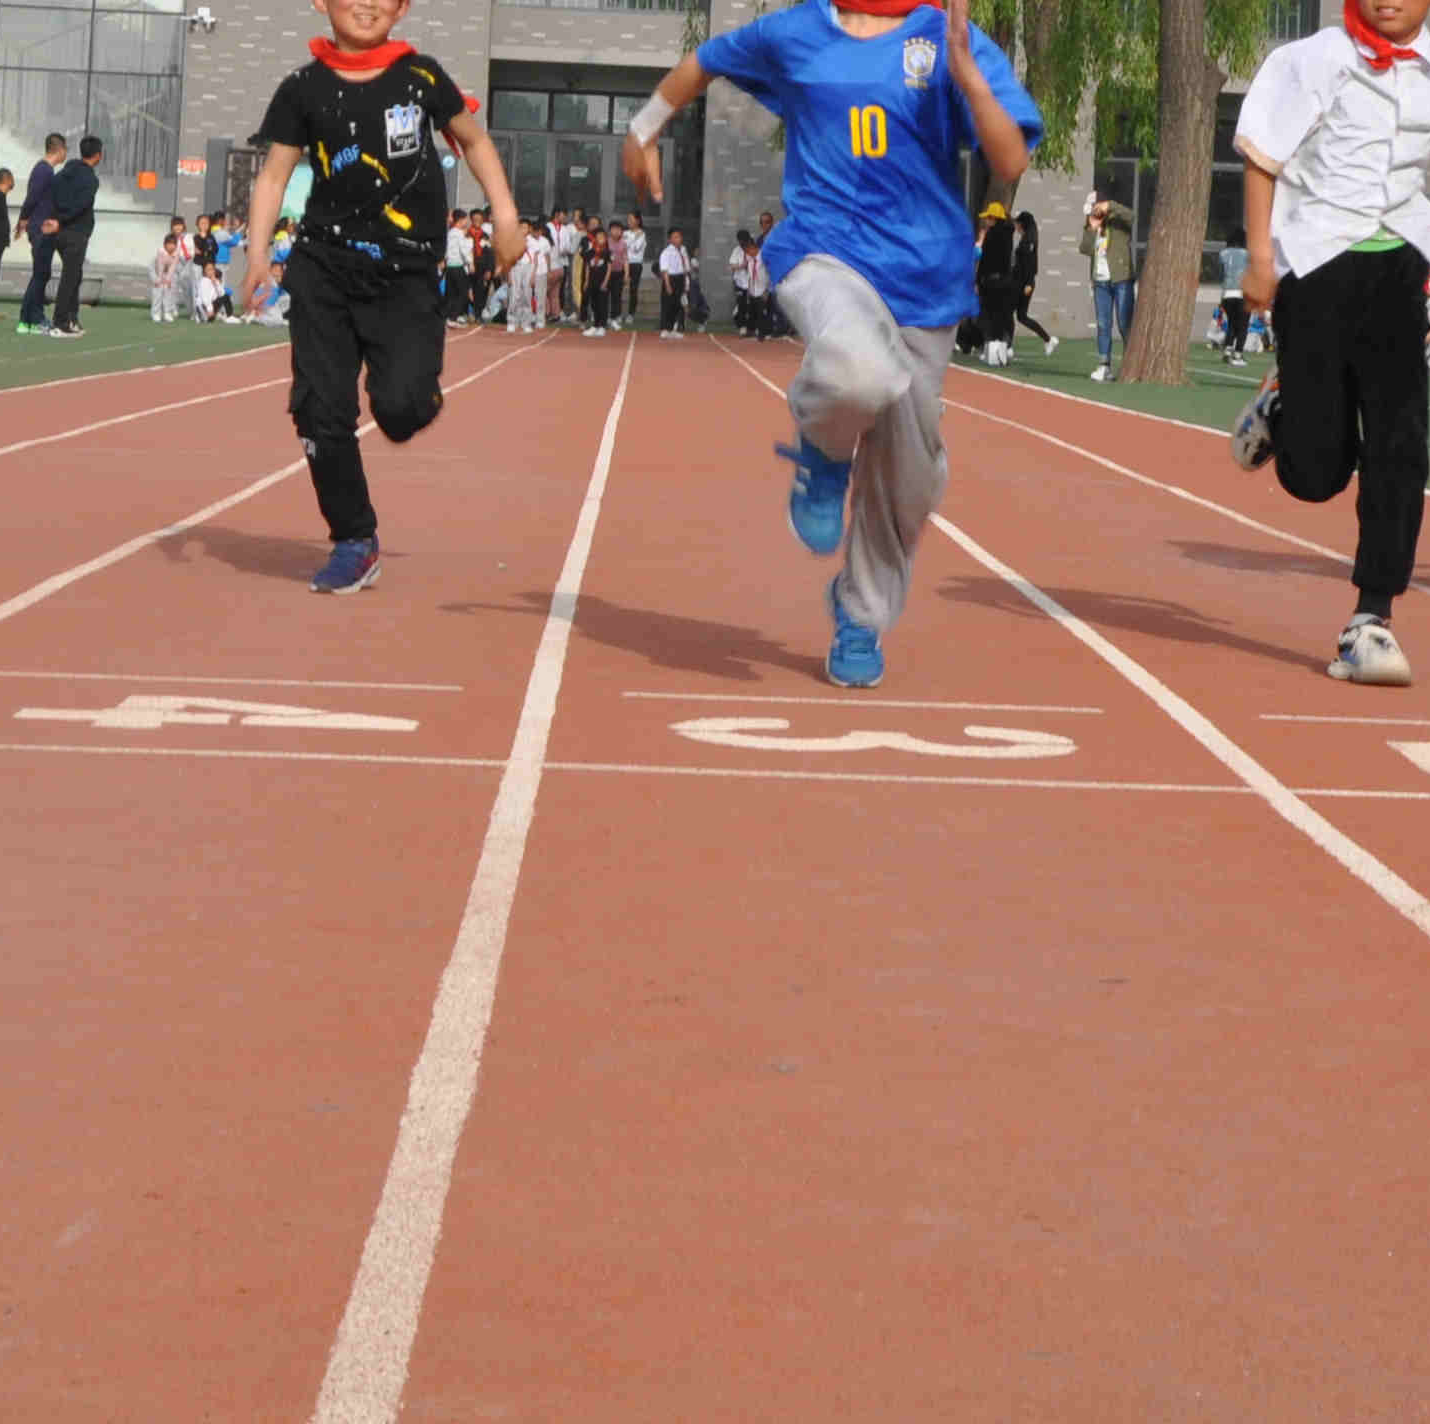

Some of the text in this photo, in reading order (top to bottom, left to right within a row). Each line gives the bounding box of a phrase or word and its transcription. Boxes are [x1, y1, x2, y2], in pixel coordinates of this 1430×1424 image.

[849, 104, 888, 159] 10
[13, 695, 420, 732] 4
[668, 717, 1078, 760] 3
